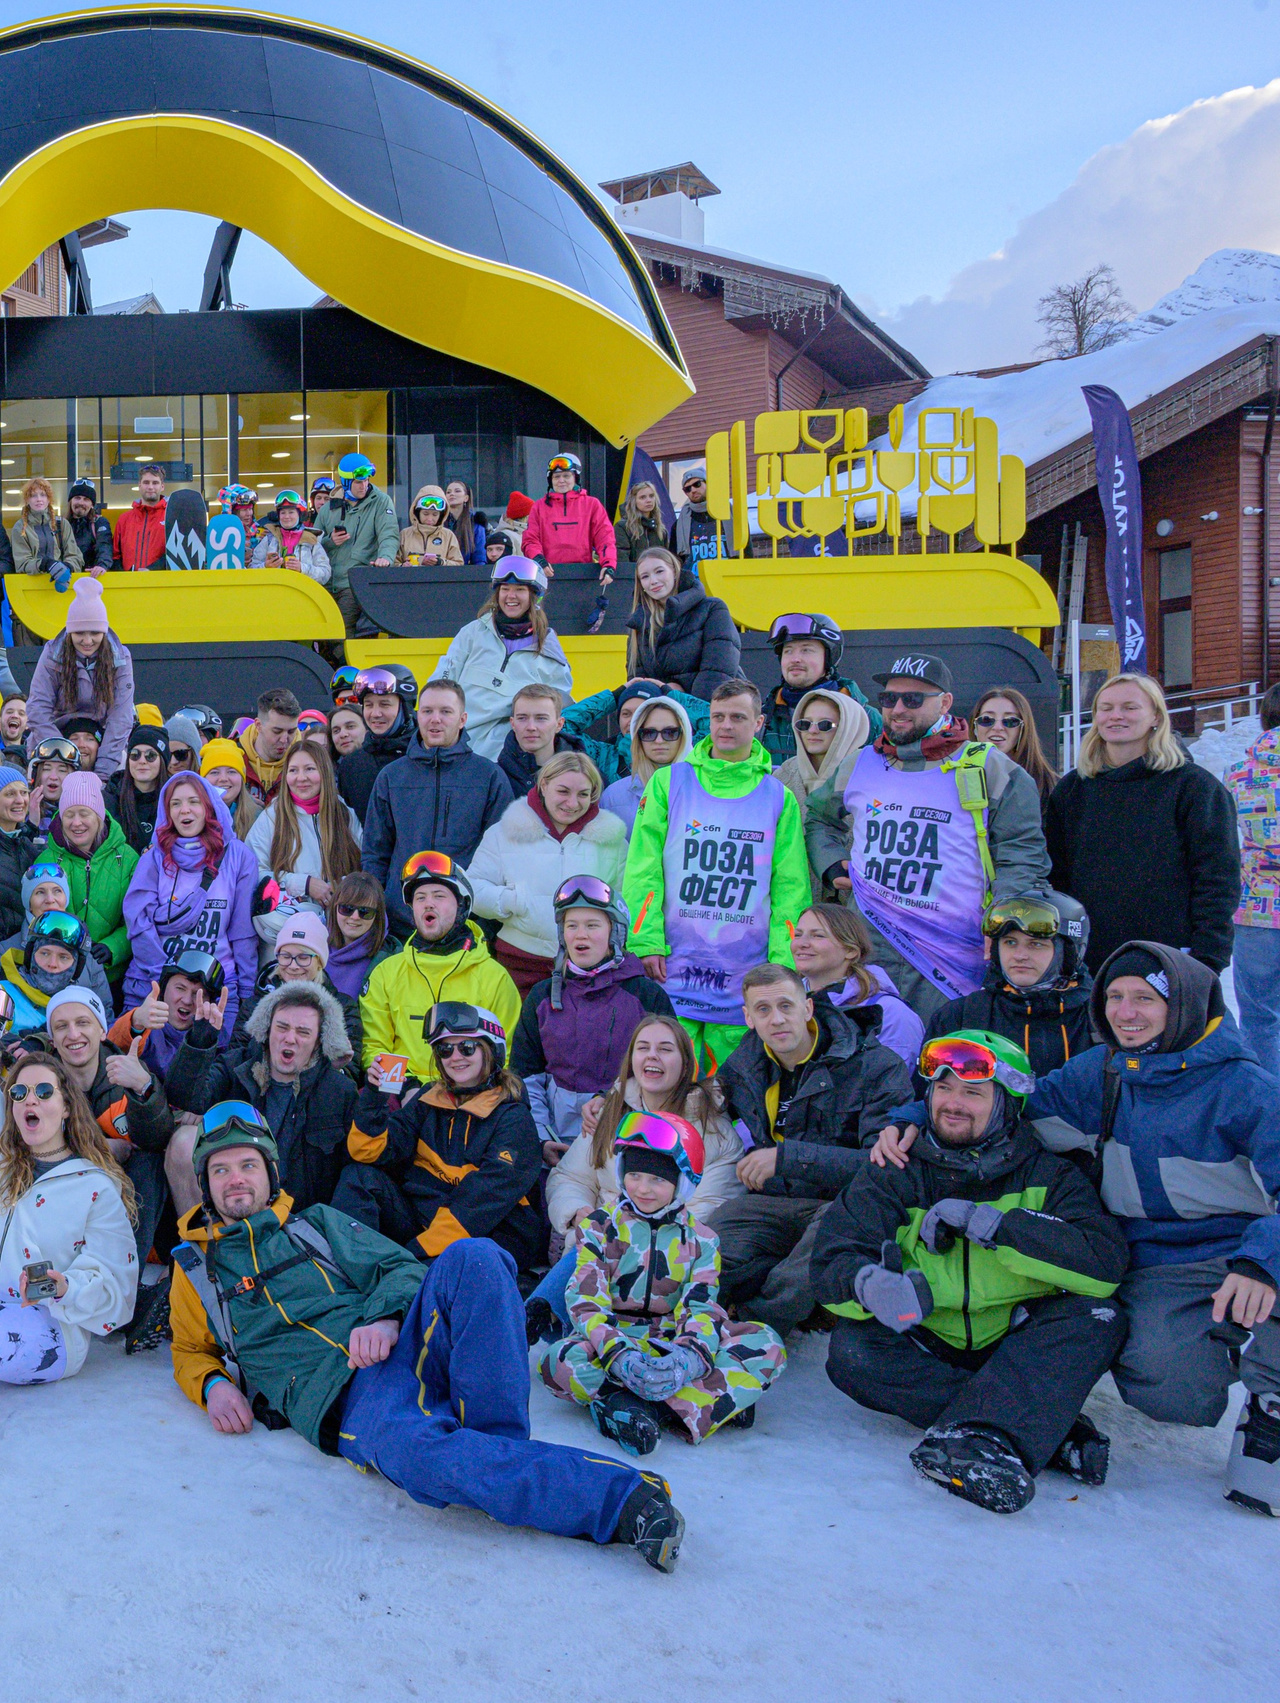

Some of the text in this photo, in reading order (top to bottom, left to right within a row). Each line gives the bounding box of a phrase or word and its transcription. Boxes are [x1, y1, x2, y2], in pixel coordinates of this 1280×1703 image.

[883, 803, 902, 812] сбп
[924, 809, 950, 822] СЕЗОН
[741, 831, 763, 842] СЕЗОН
[863, 819, 939, 861] РОЗА
[683, 838, 755, 877] РОЗА
[864, 857, 943, 897] ФЕСТ
[678, 873, 758, 911] ФЕСТ
[891, 896, 903, 905] НА
[905, 898, 941, 912] ВЫСОТЕ
[678, 908, 755, 925] ОБЩЕНИЕ НА ВЫСОТЕ
[871, 915, 916, 957] Avito Team
[683, 1000, 730, 1013] Avito Team
